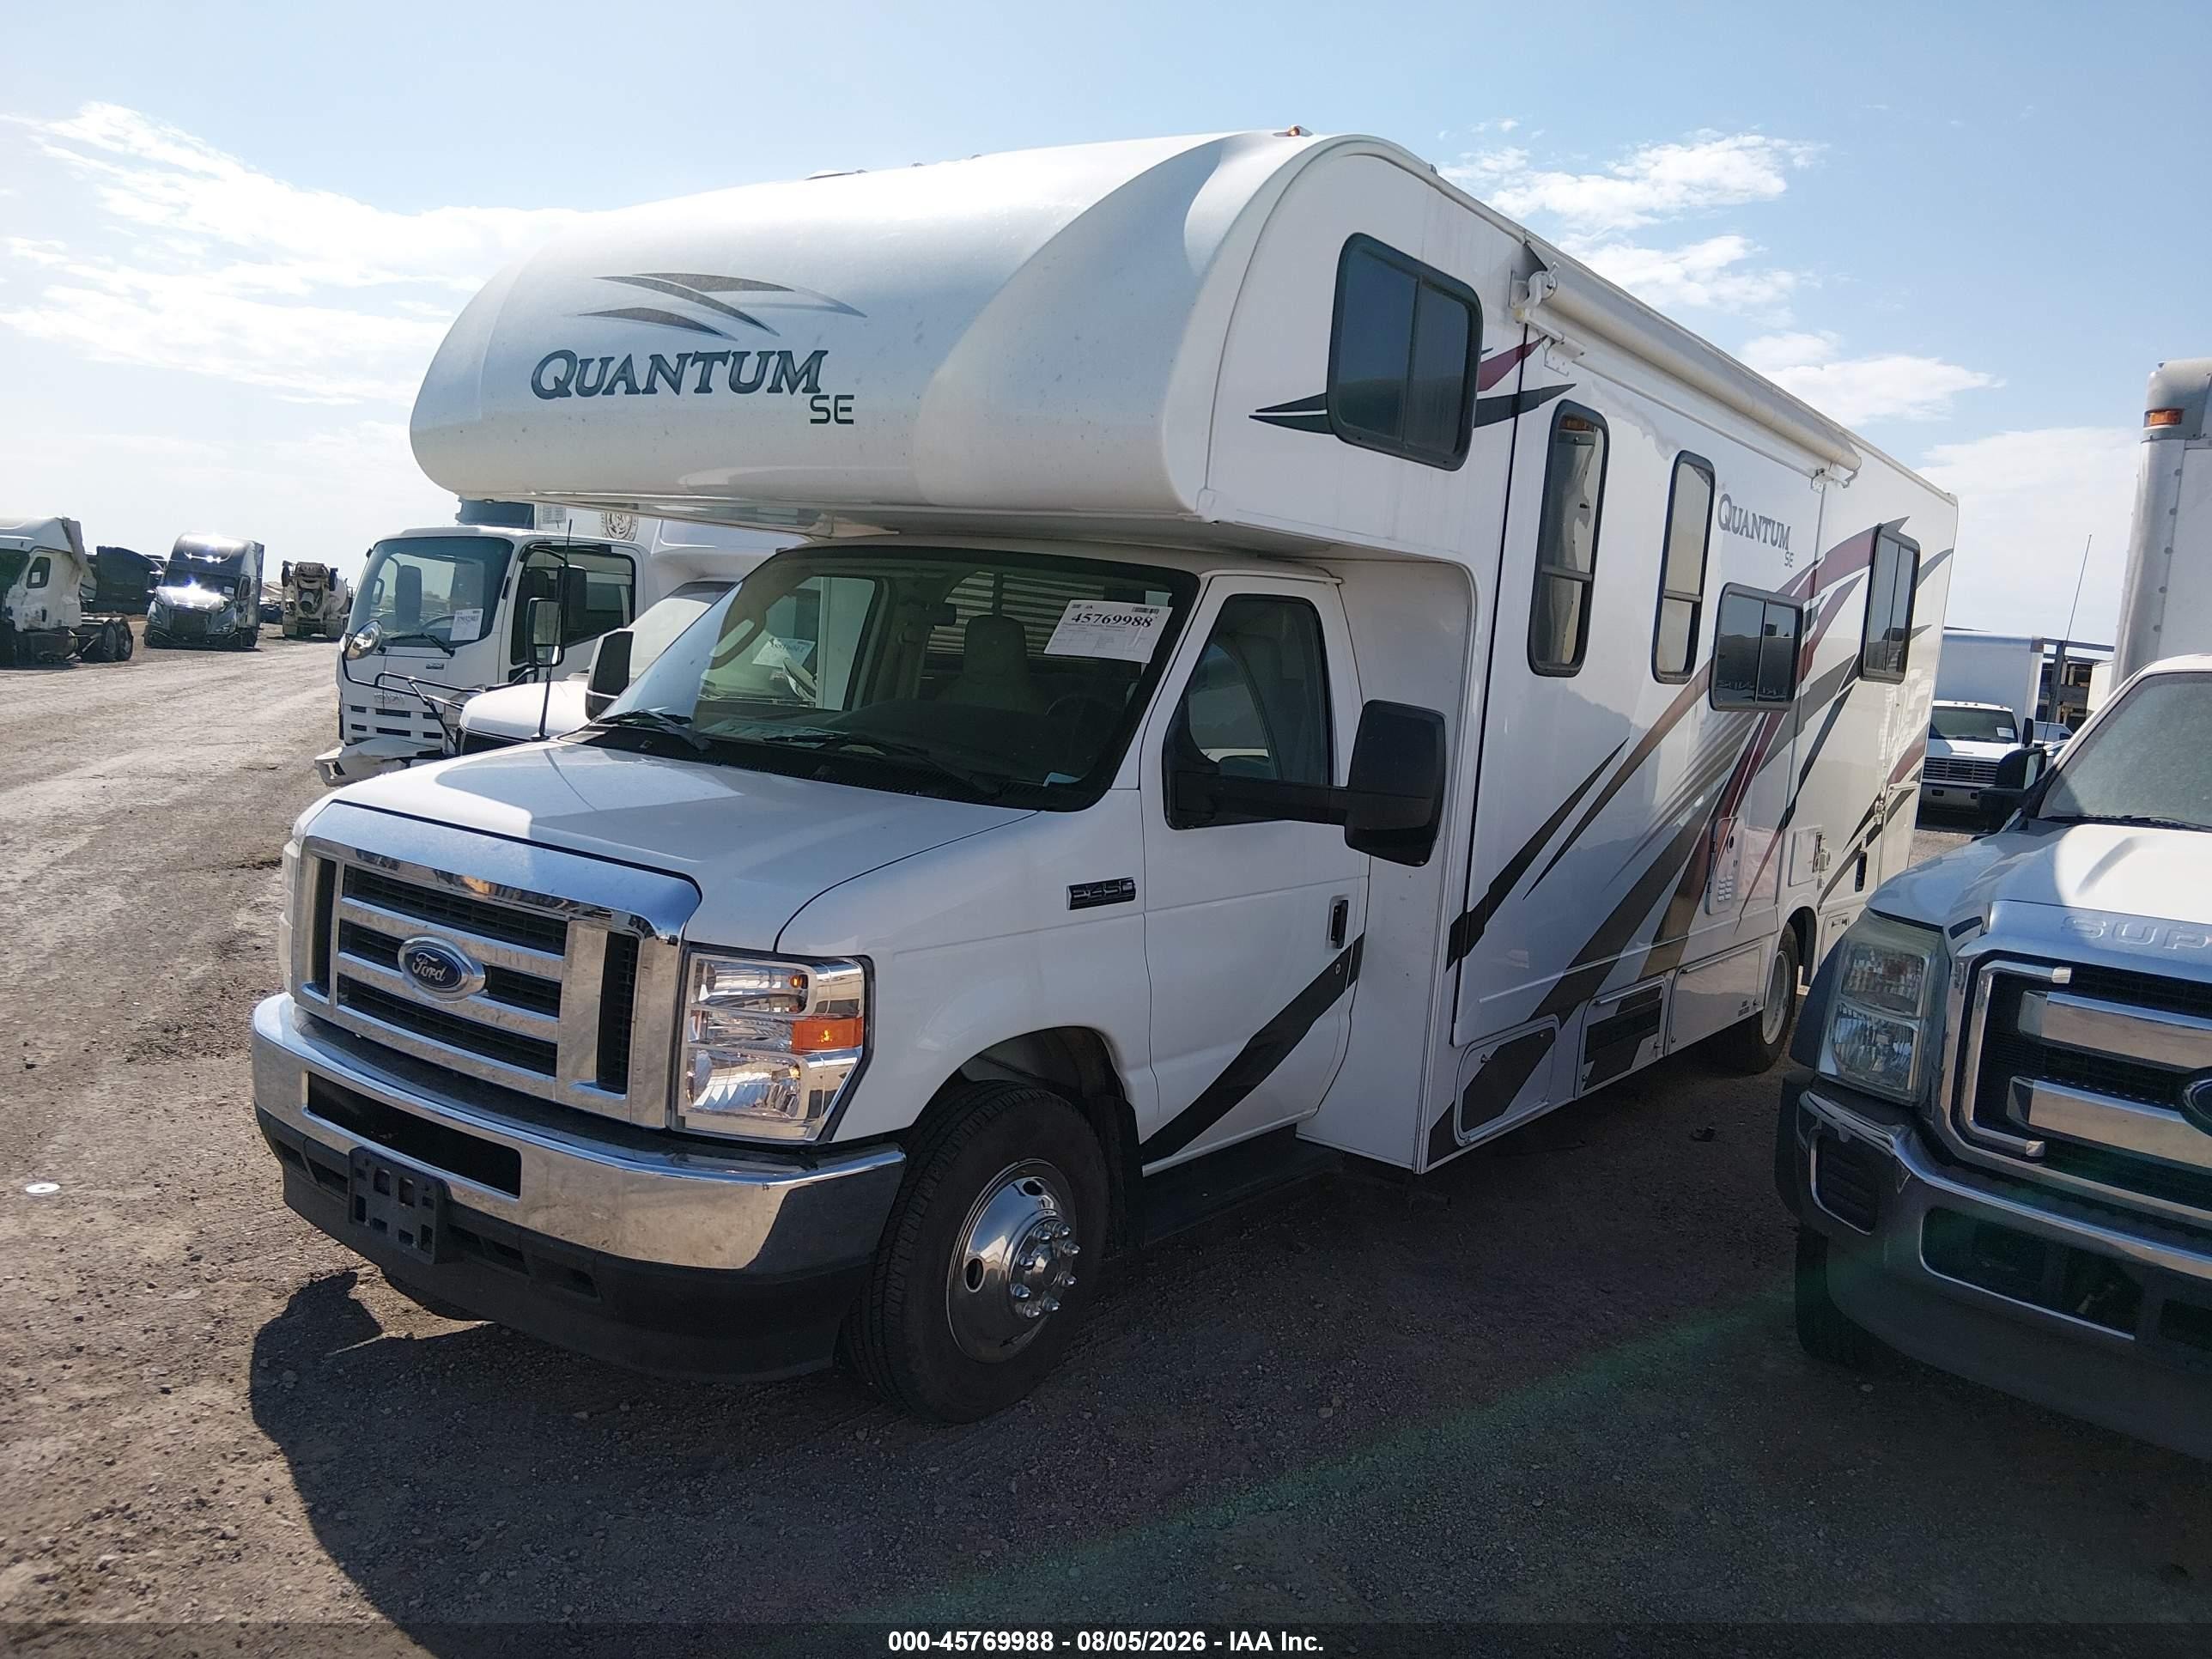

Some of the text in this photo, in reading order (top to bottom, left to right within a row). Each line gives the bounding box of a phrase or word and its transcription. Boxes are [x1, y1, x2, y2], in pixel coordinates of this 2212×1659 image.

[531, 349, 829, 399] QUANTUM
[810, 394, 854, 424] SE
[1717, 493, 1791, 550] QUANTUM
[1784, 551, 1794, 568] SE
[1071, 612, 1153, 628] 45769988
[412, 952, 447, 981] Ford
